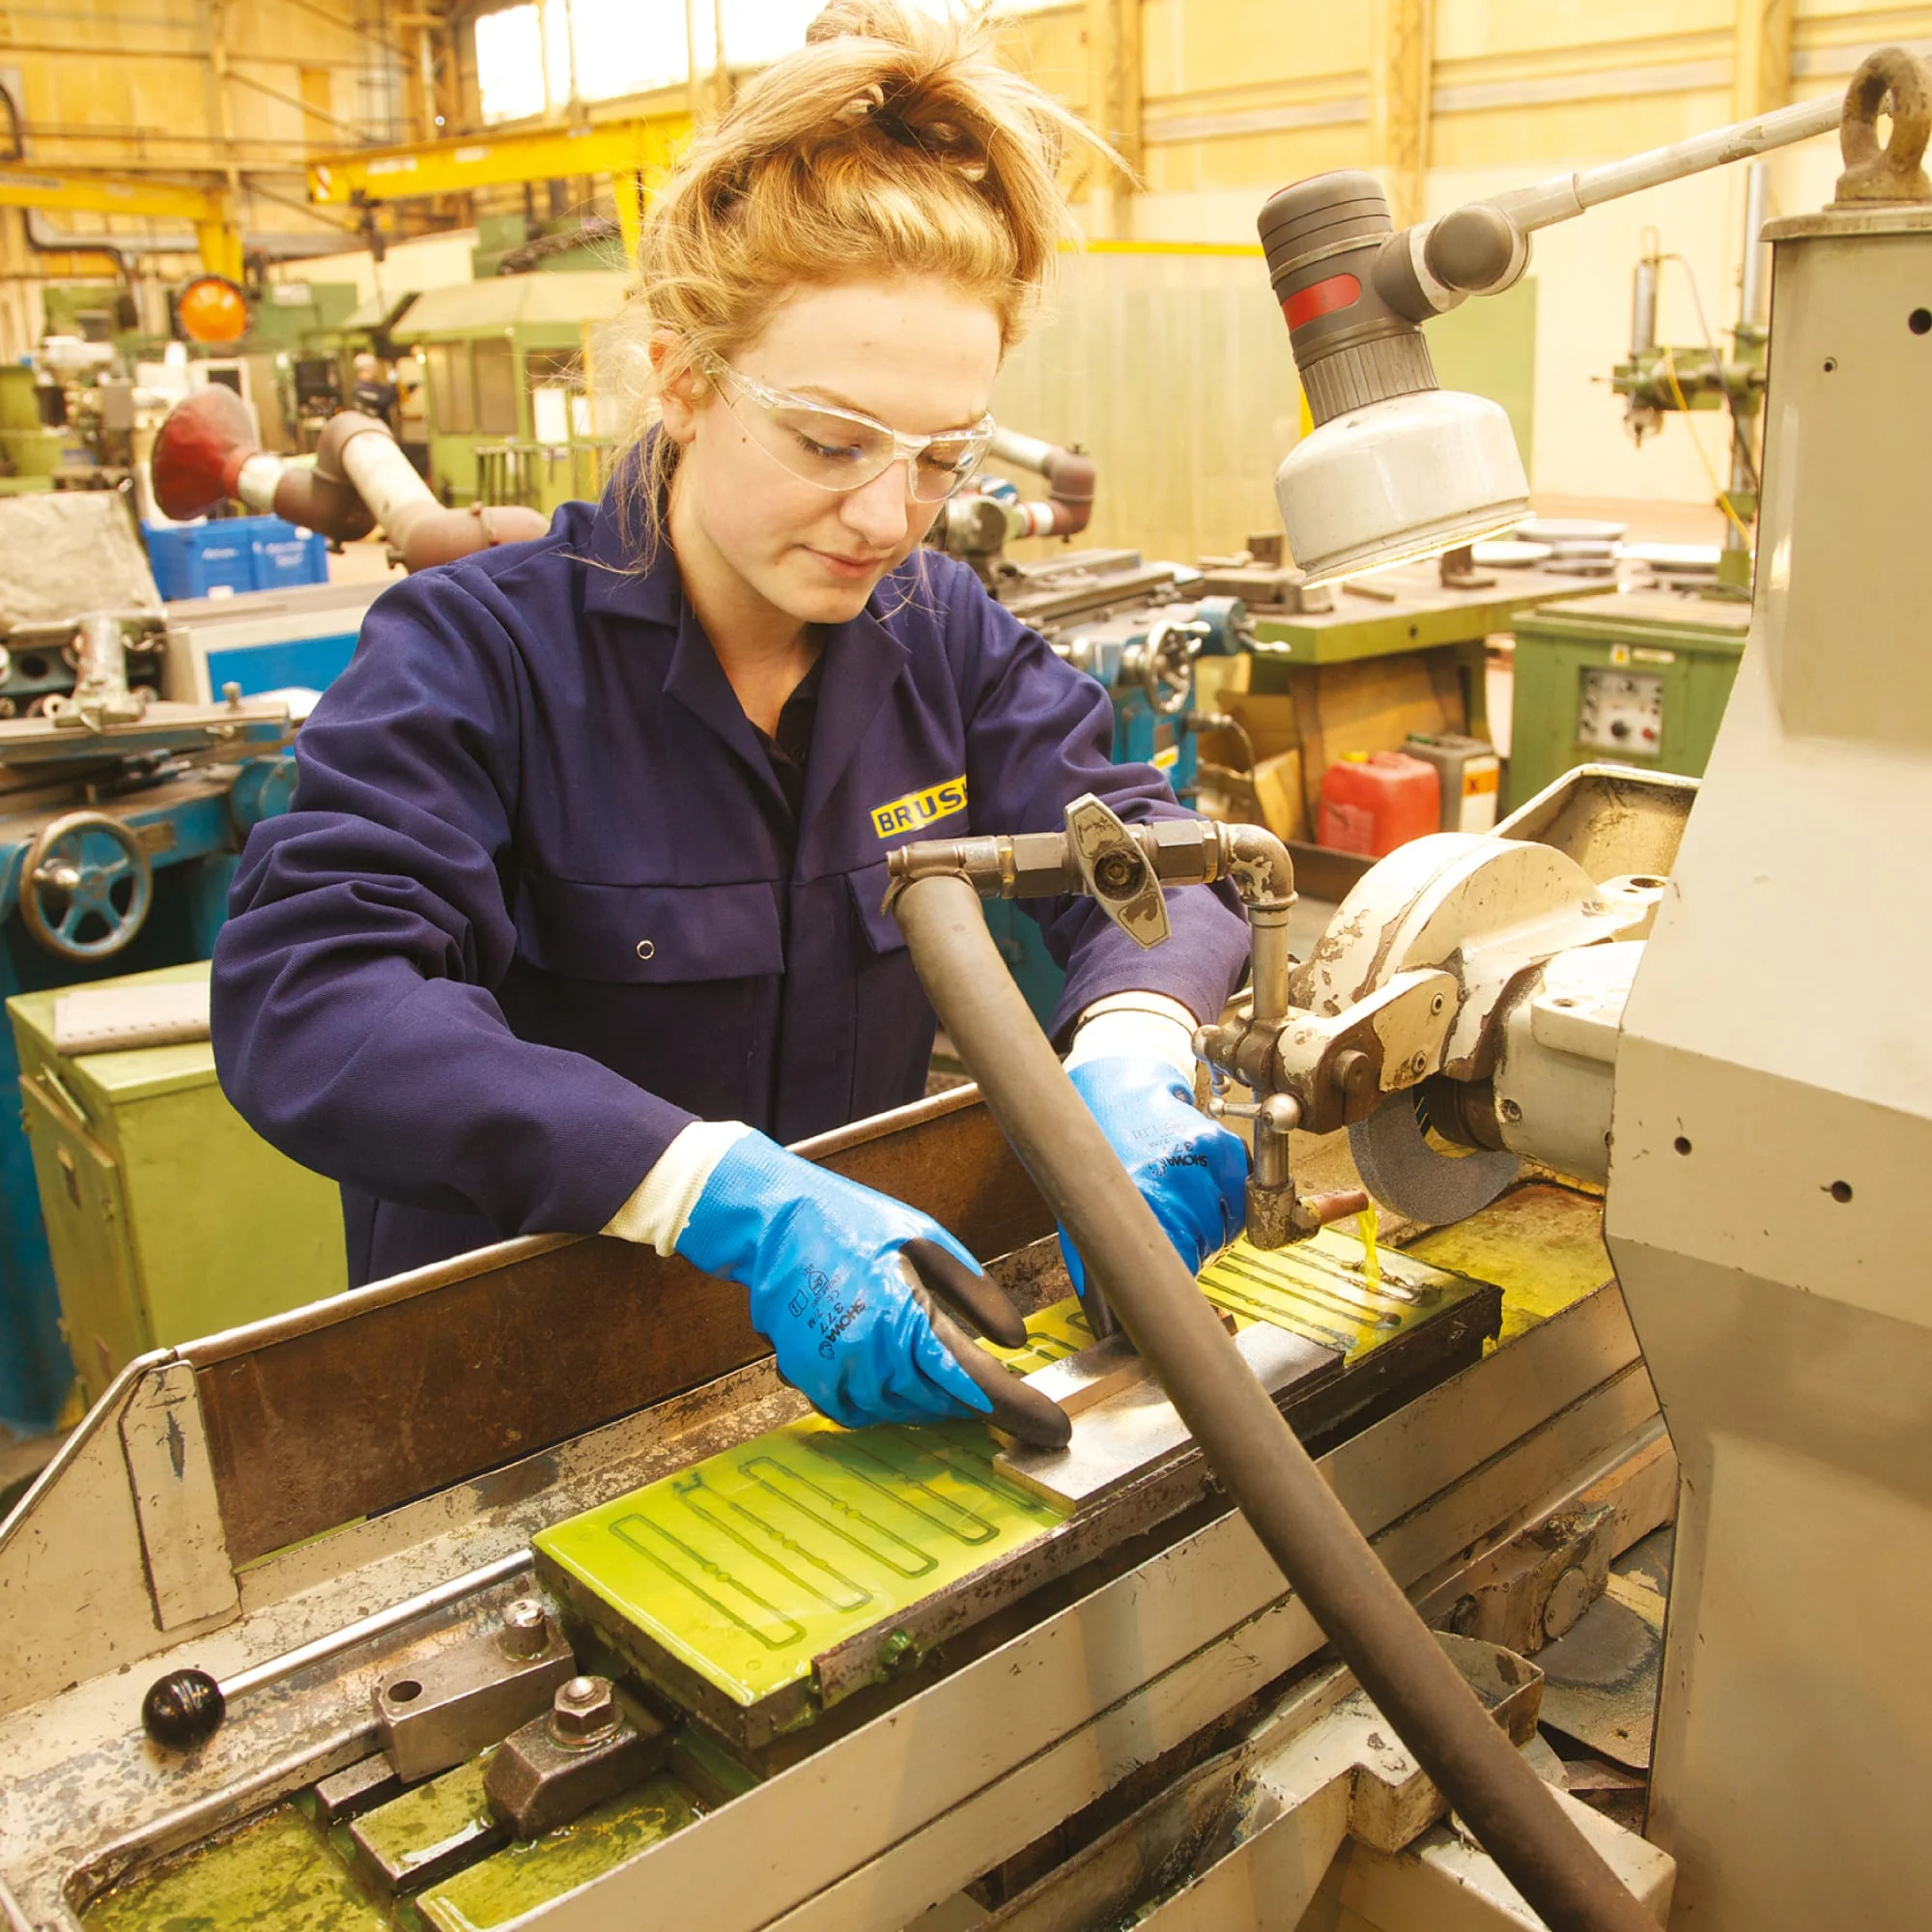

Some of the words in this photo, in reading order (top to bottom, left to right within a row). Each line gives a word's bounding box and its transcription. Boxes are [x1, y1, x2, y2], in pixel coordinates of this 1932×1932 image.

[1165, 1154, 1208, 1168] SHOWA
[819, 1301, 843, 1335] 377
[825, 1298, 867, 1343] SHOWA
